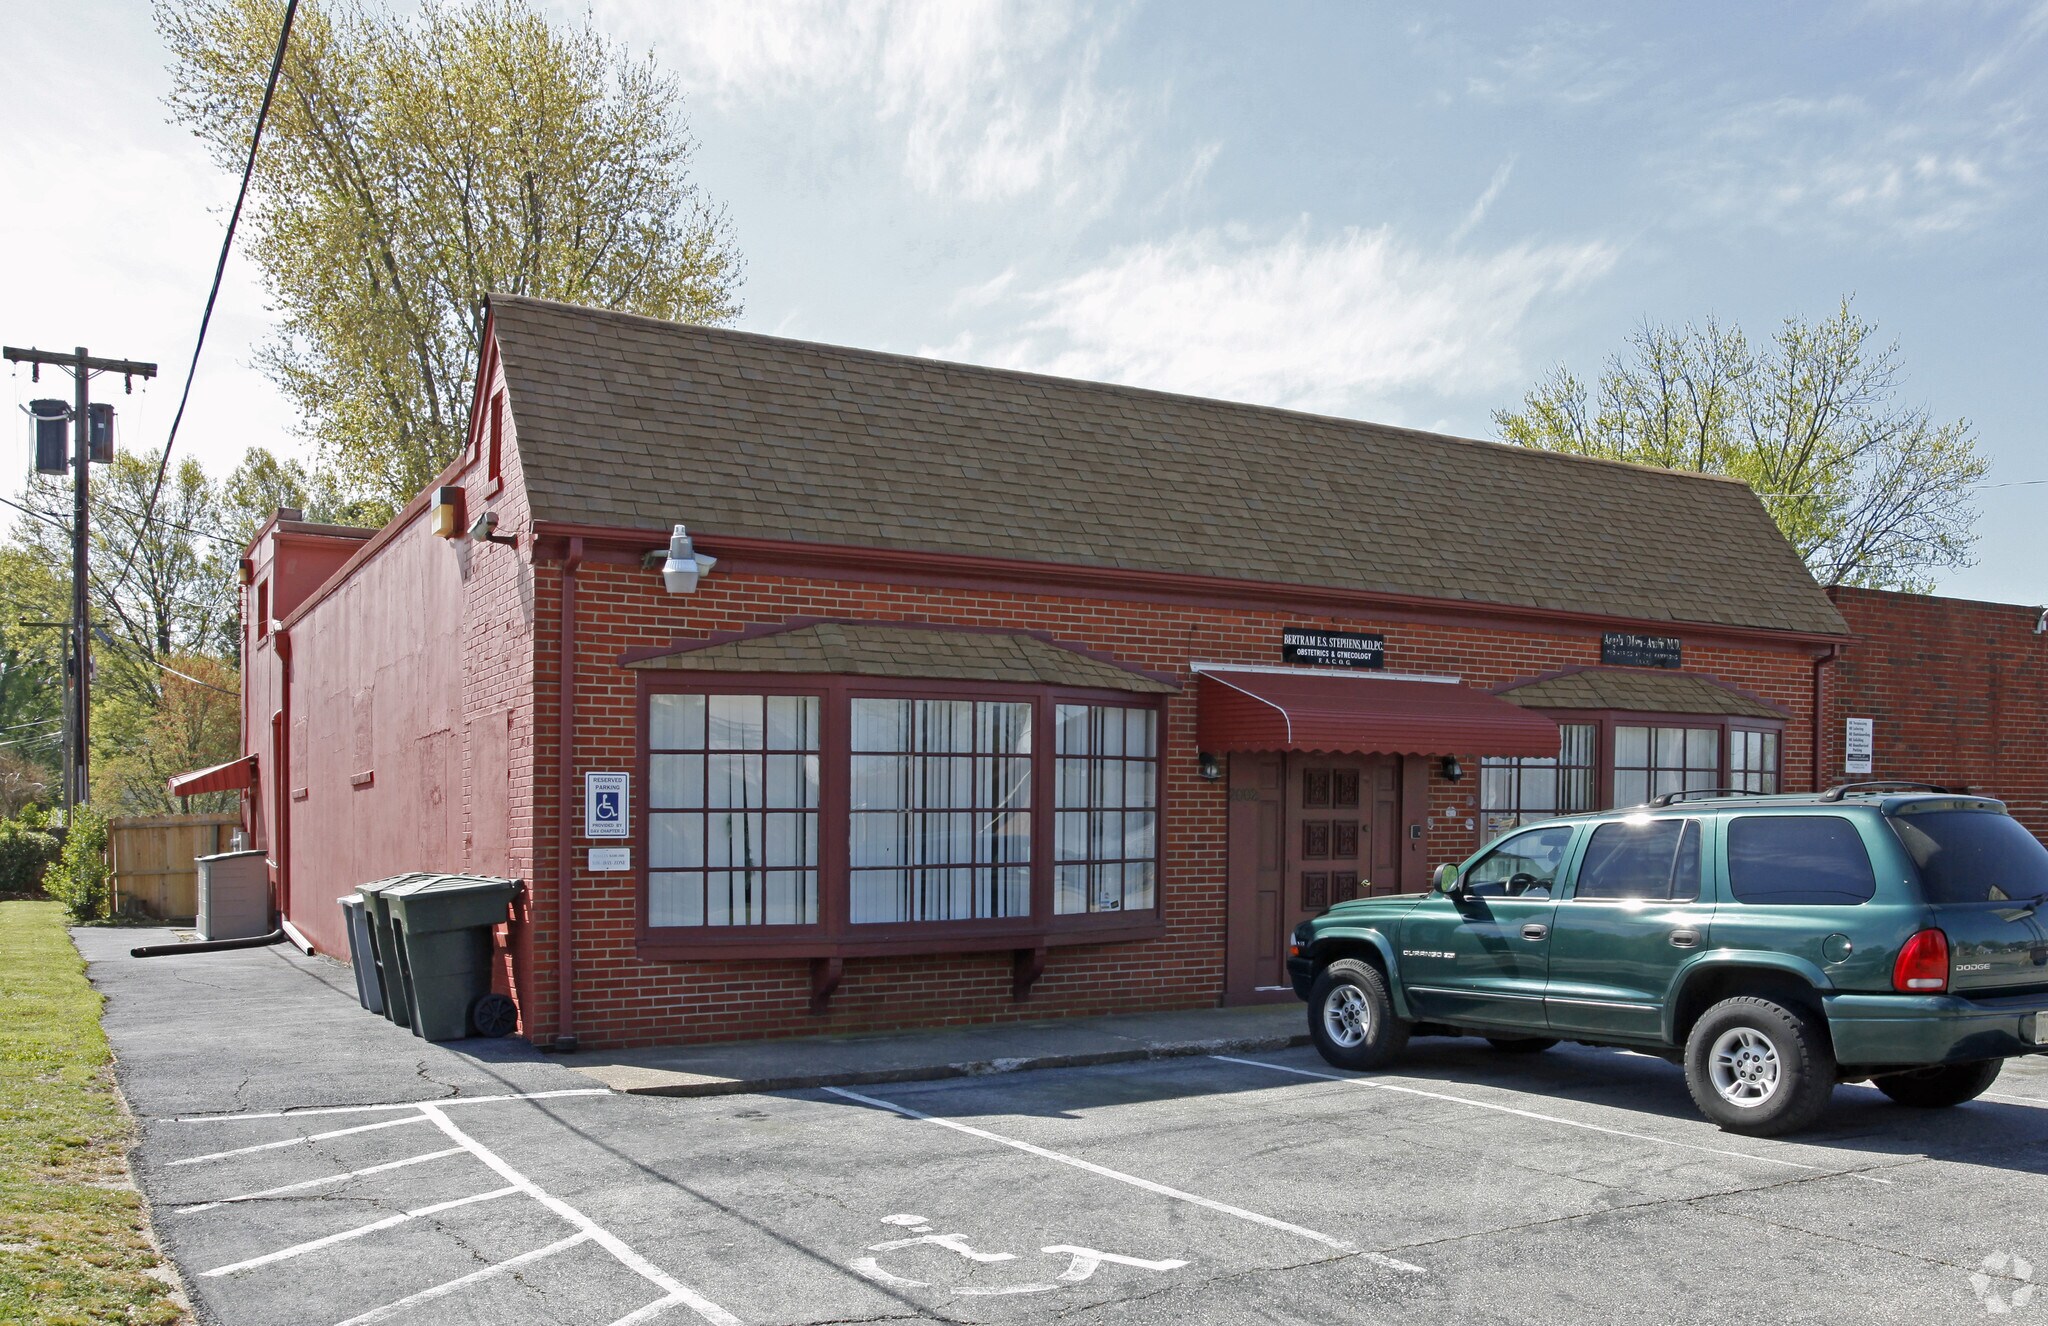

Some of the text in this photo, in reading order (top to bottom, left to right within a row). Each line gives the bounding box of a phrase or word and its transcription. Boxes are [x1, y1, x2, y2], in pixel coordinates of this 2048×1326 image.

[1284, 634, 1315, 646] BERTRAM
[1317, 637, 1328, 647] E.S.
[1297, 648, 1372, 660] OBSTETRICS & GYNECOLOGY
[1956, 963, 1990, 971] DODGE
